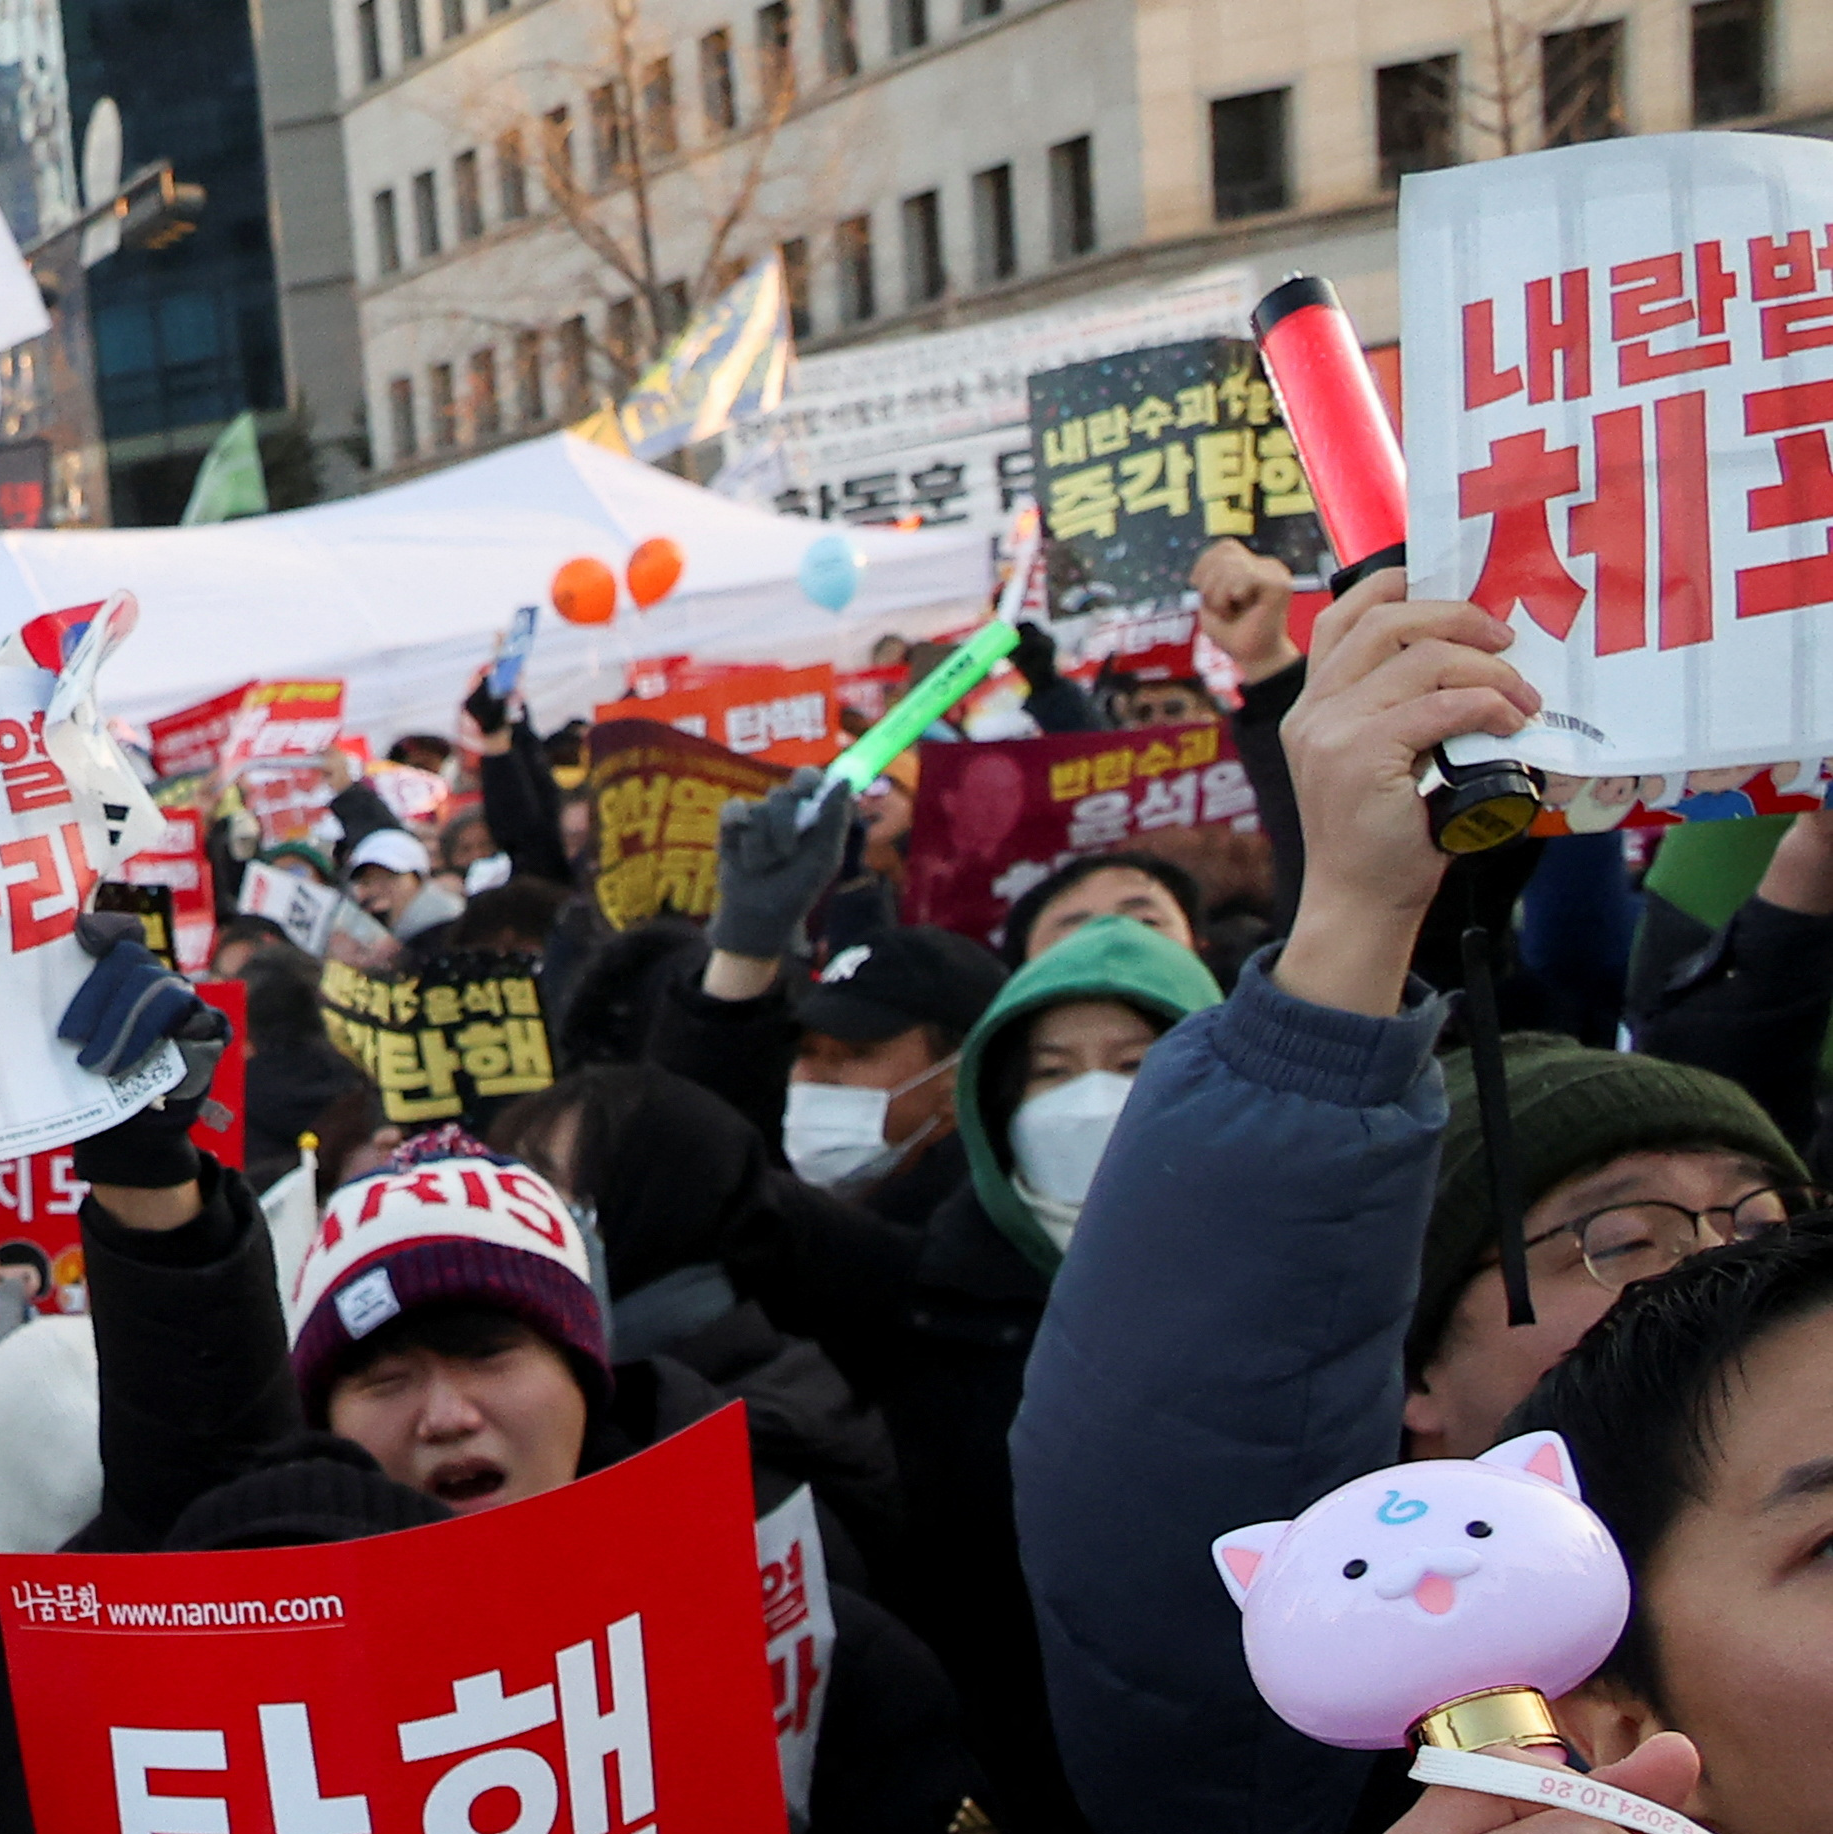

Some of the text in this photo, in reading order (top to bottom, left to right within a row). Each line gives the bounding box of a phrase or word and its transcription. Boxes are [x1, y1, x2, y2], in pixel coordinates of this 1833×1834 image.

[1042, 382, 1220, 468] 내란수괴
[11, 1580, 345, 1627] 나눔문화 www.nanum.com
[1538, 1776, 1679, 1834] 2024.10.26
